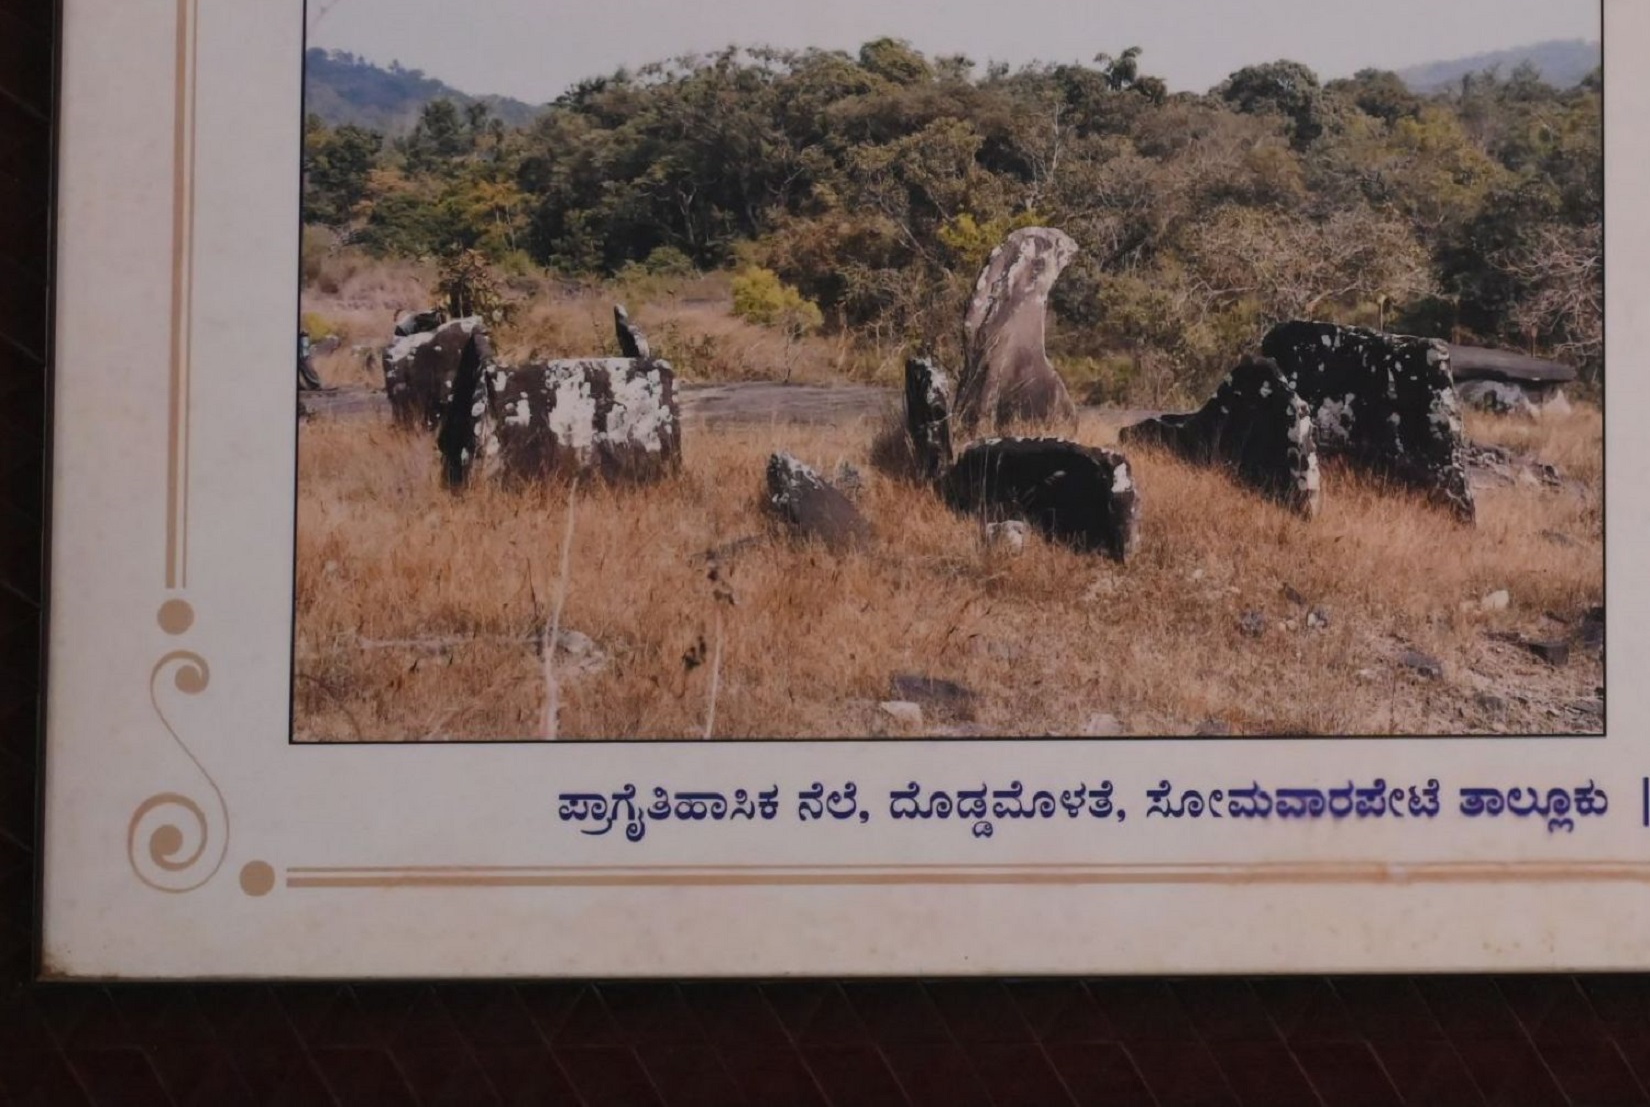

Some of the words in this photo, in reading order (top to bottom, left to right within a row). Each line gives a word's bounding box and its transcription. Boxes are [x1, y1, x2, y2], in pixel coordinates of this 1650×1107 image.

[797, 781, 870, 824] ನೆಲೆ,
[889, 779, 1127, 838] ದೊಡ್ಡಮೊಳತೆ,
[1145, 777, 1441, 821] ಸೋಮವಾರಪೇಟೆ
[1458, 778, 1609, 834] ತಾಲ್ಲೂಕು
